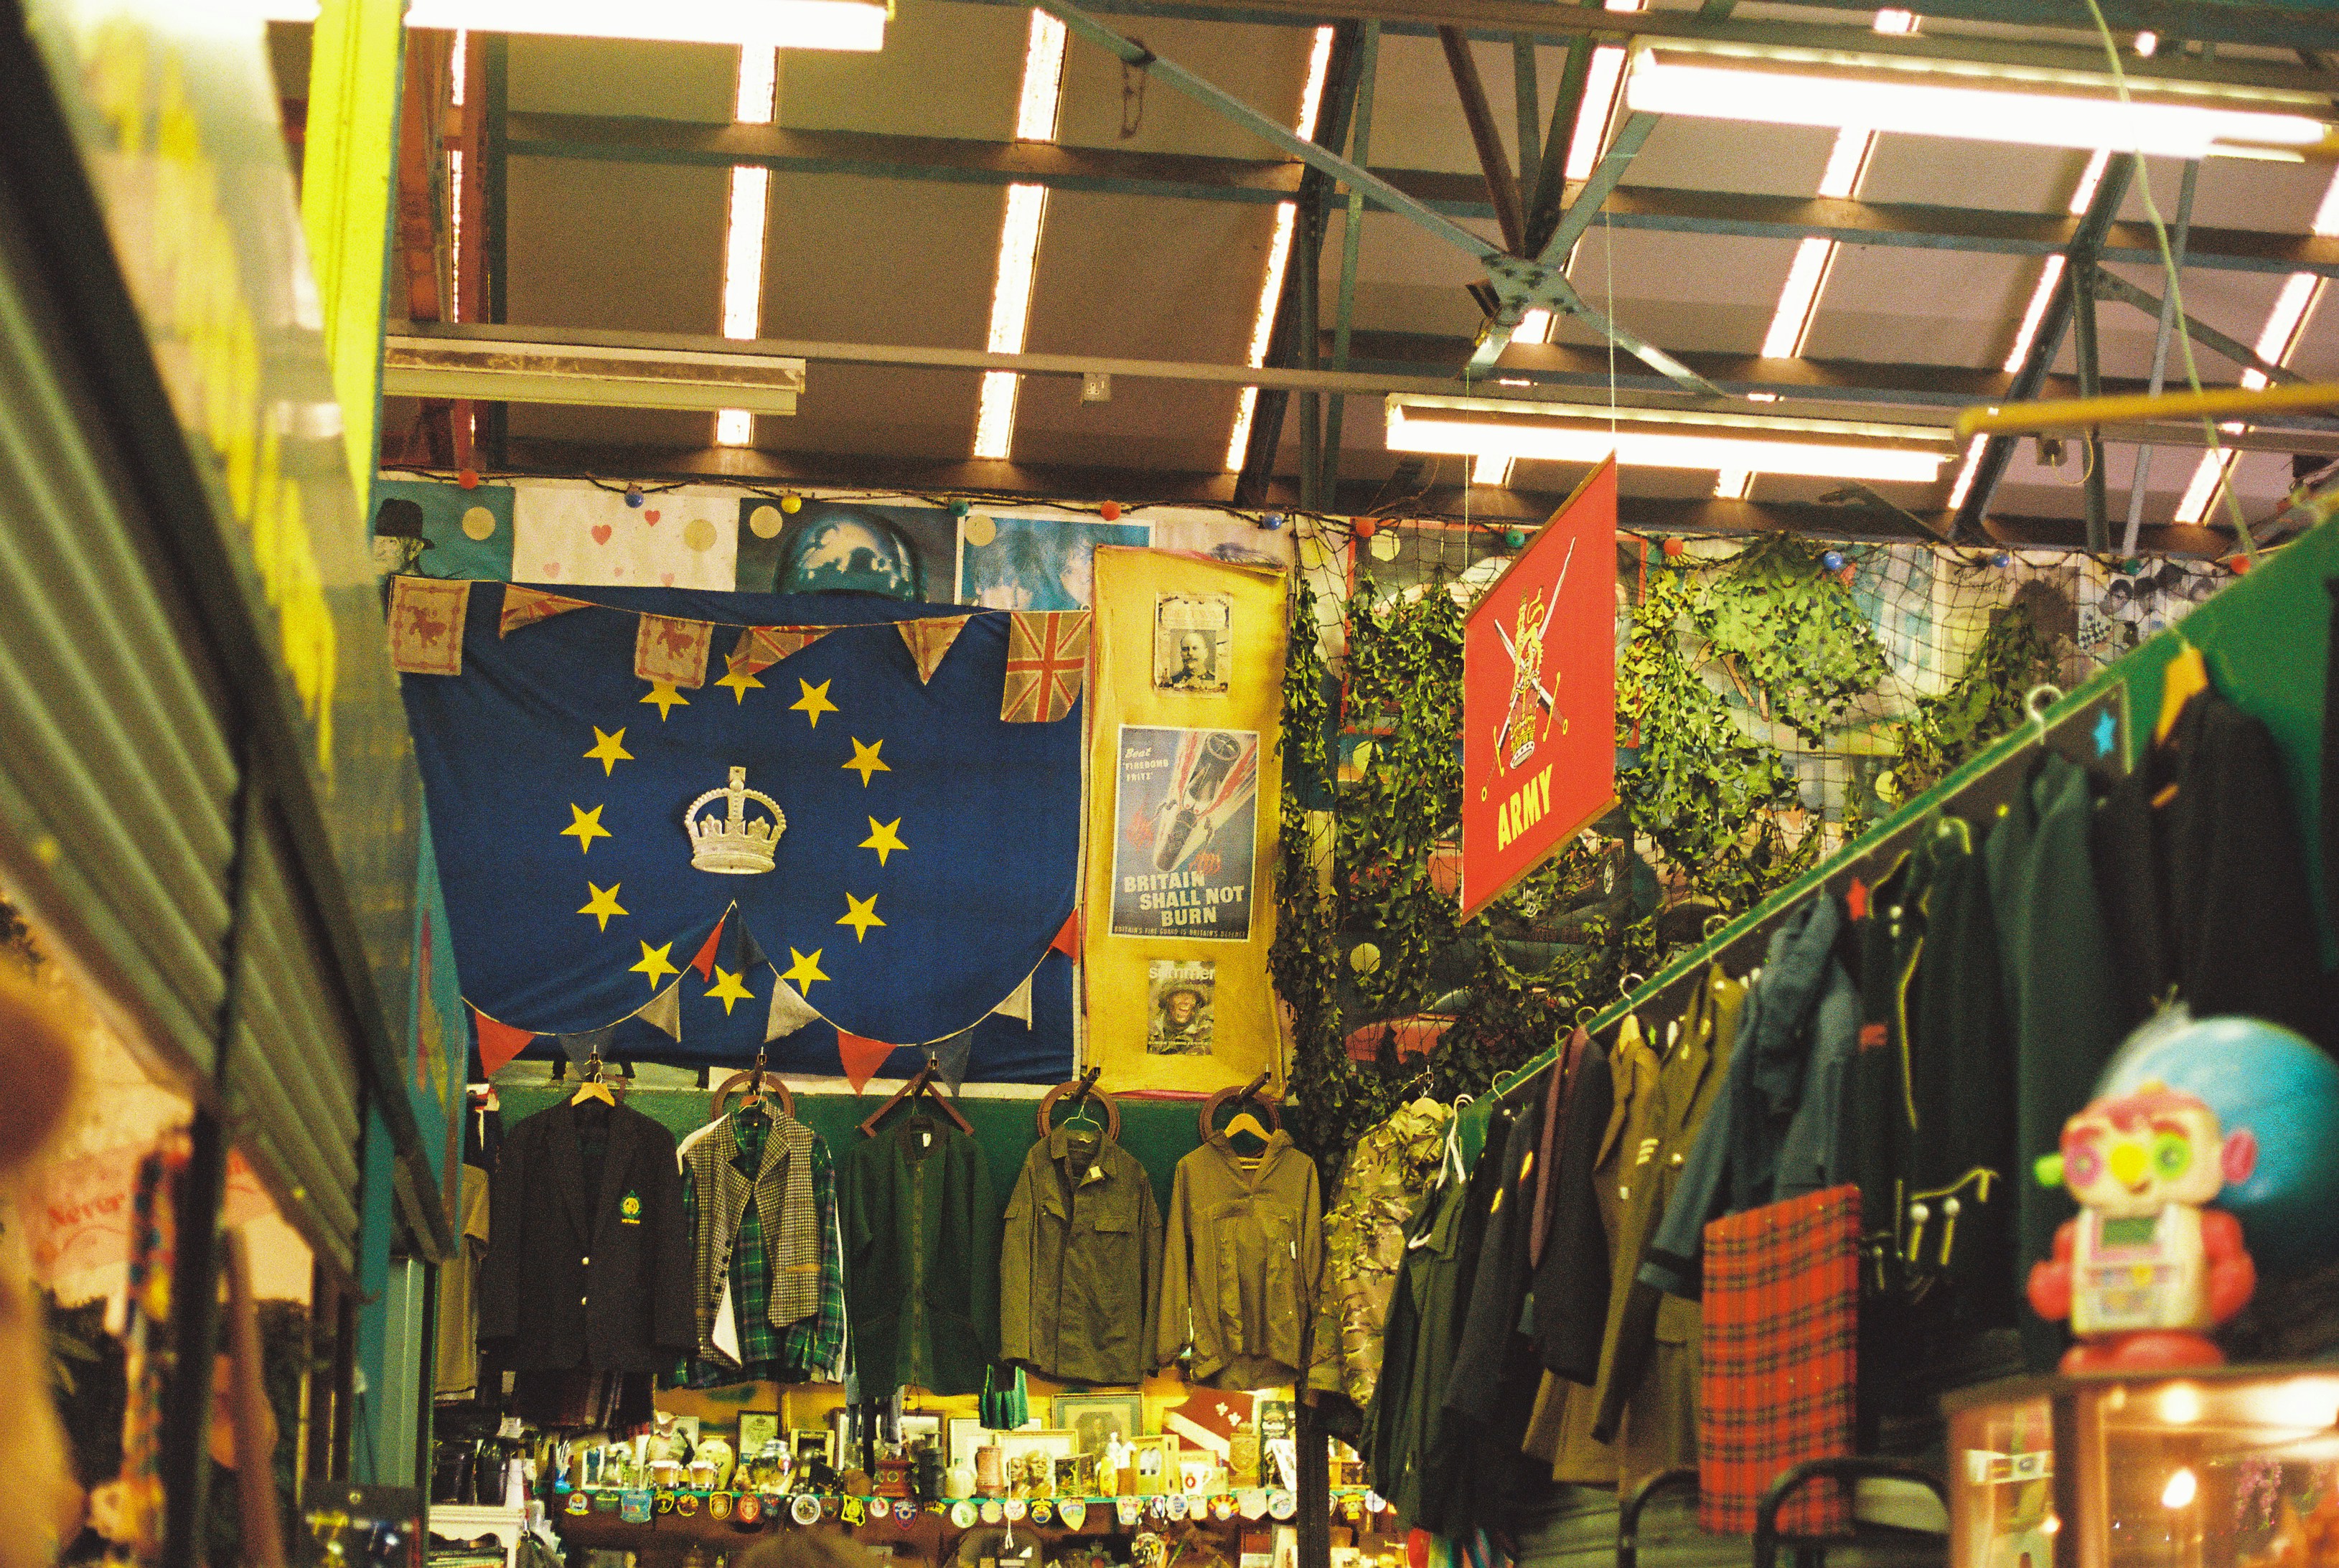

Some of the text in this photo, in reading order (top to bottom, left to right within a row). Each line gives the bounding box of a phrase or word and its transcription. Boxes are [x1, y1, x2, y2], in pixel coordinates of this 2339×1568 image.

[1125, 747, 1152, 758] Beat
[1498, 763, 1552, 853] ARMY
[1124, 870, 1206, 893] BRITAIN
[1139, 885, 1245, 910] SHALL NOT
[1161, 906, 1217, 927] BURN
